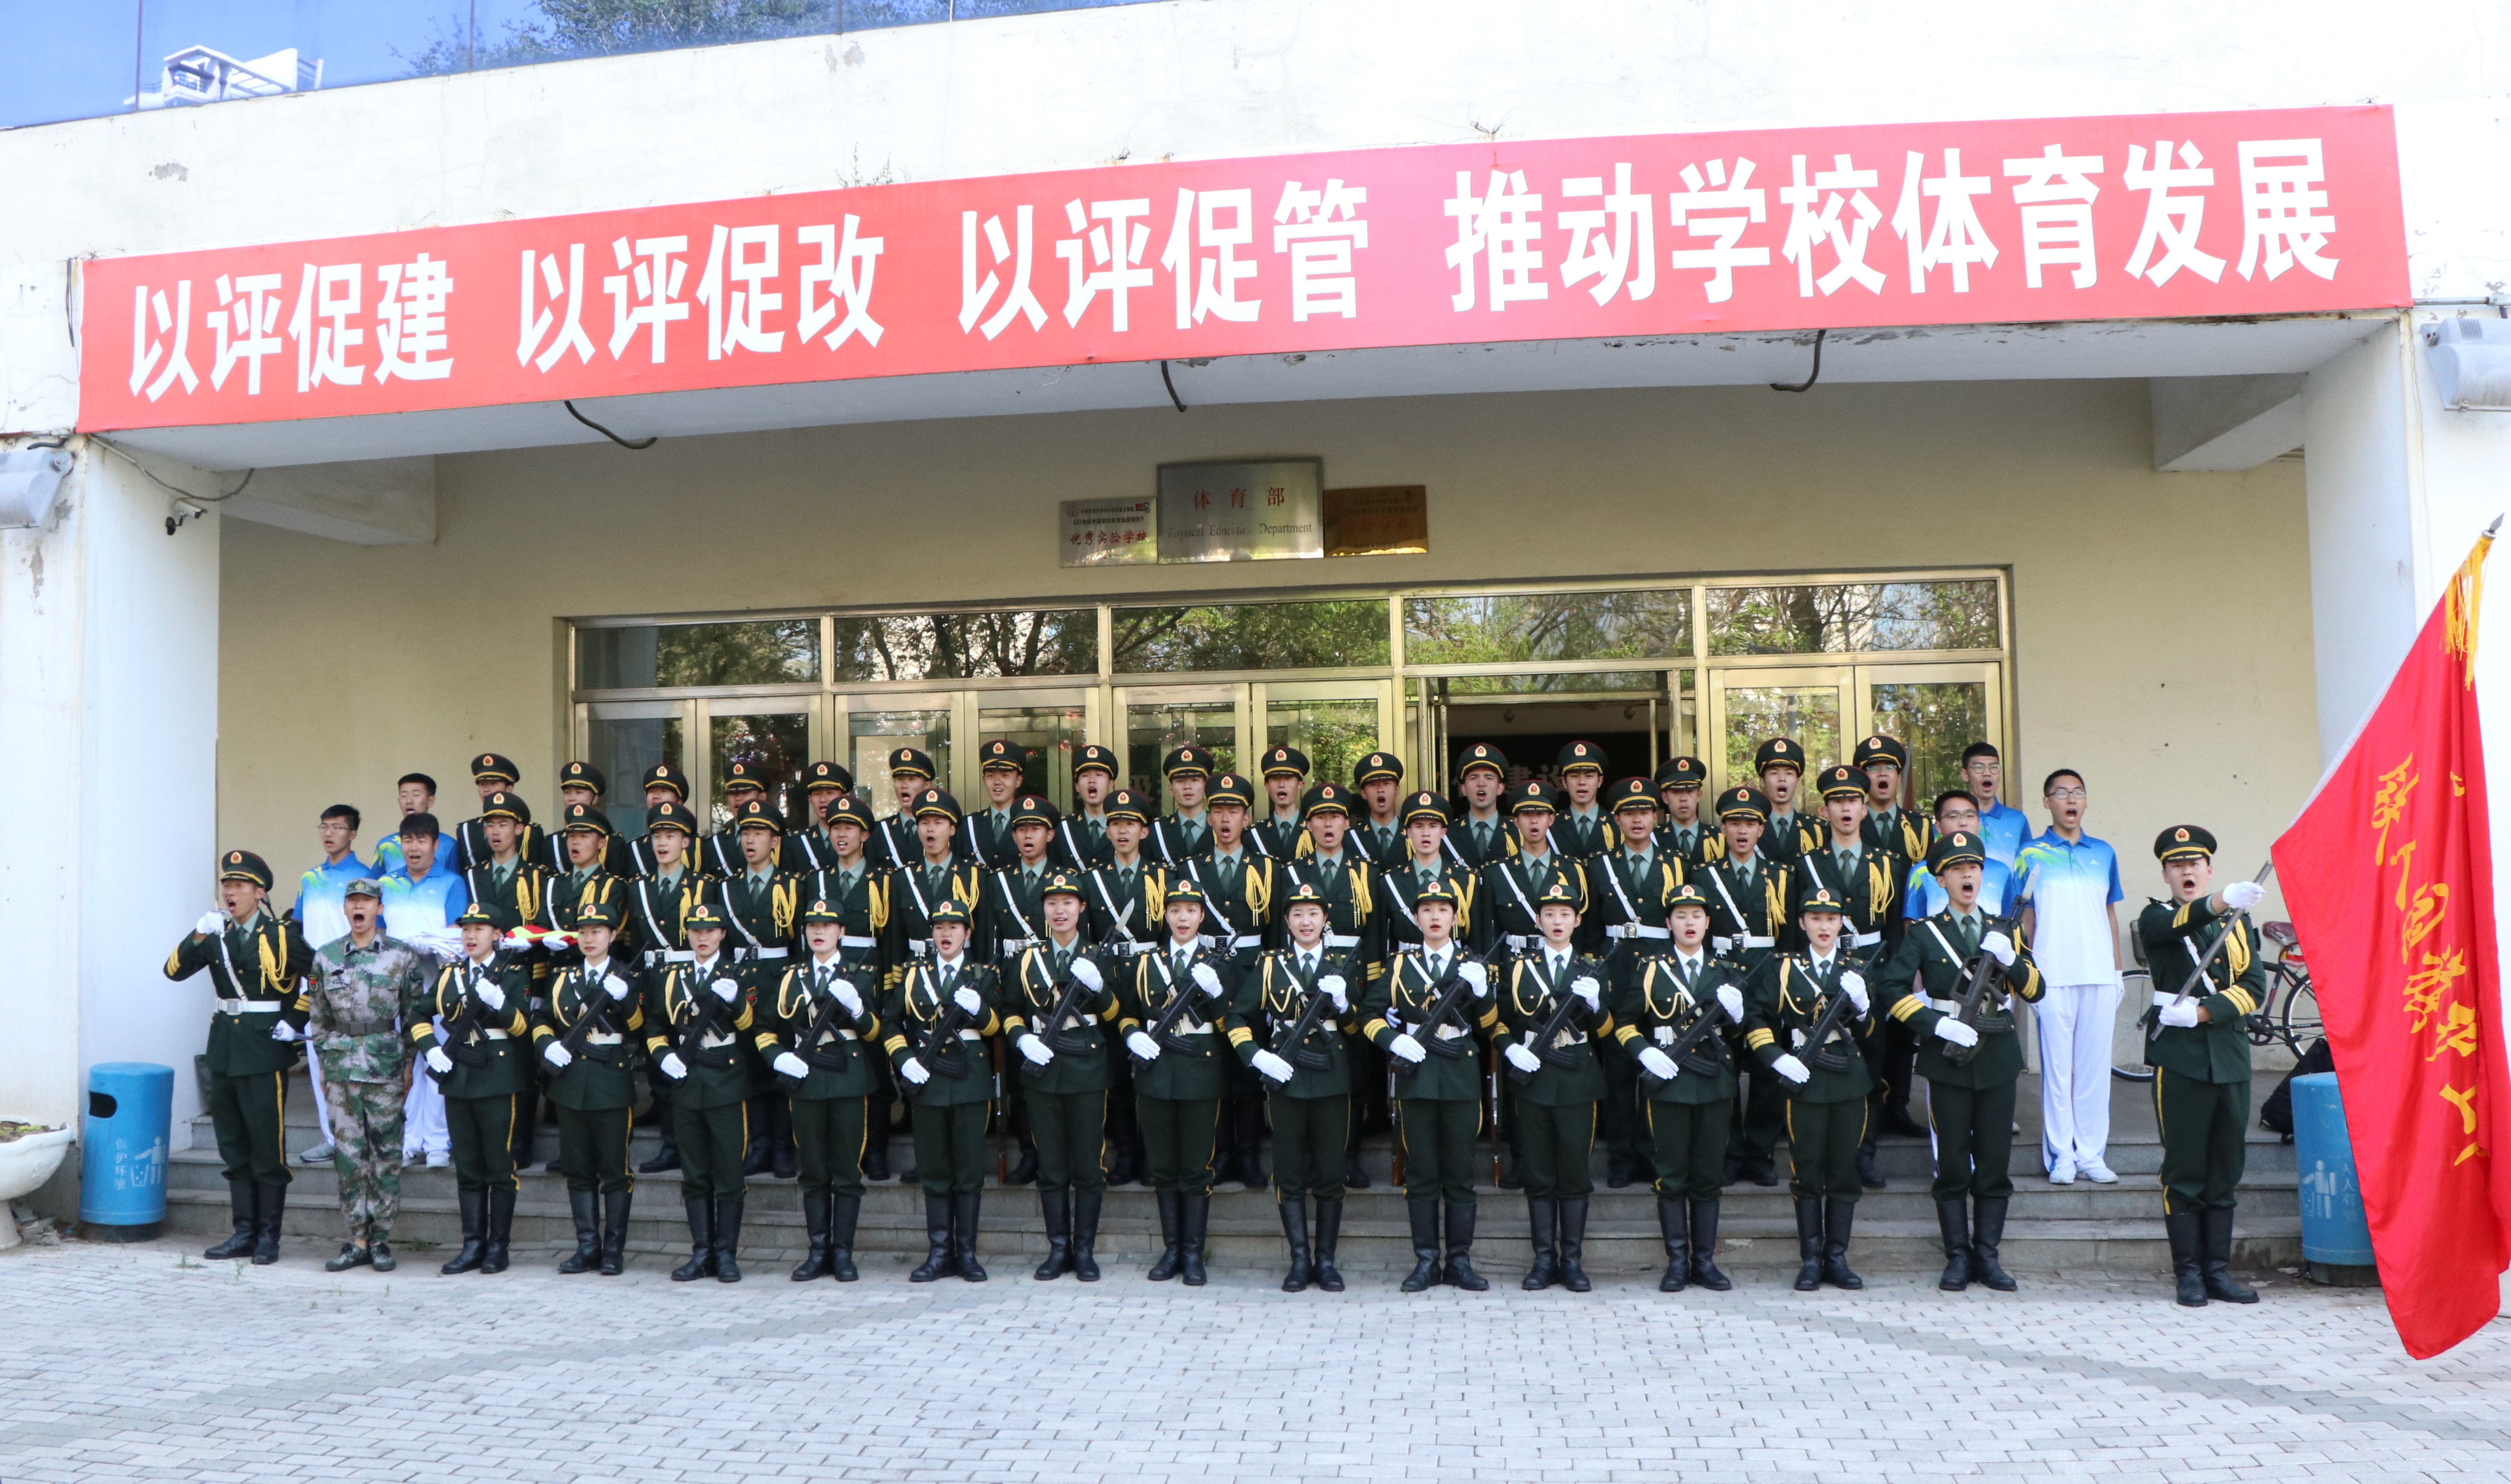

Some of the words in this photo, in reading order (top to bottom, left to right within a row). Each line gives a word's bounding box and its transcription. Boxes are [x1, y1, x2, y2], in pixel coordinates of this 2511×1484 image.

[129, 253, 454, 403] 以评促建
[516, 213, 885, 374] 以评促改
[958, 179, 1369, 341] 以评促管
[1444, 138, 2340, 313] 推动学校体育发展
[1193, 487, 1285, 510] 体育部
[1070, 530, 1148, 545] 优秀实验学校
[1260, 523, 1312, 537] Department
[114, 1138, 128, 1190] 保护环境
